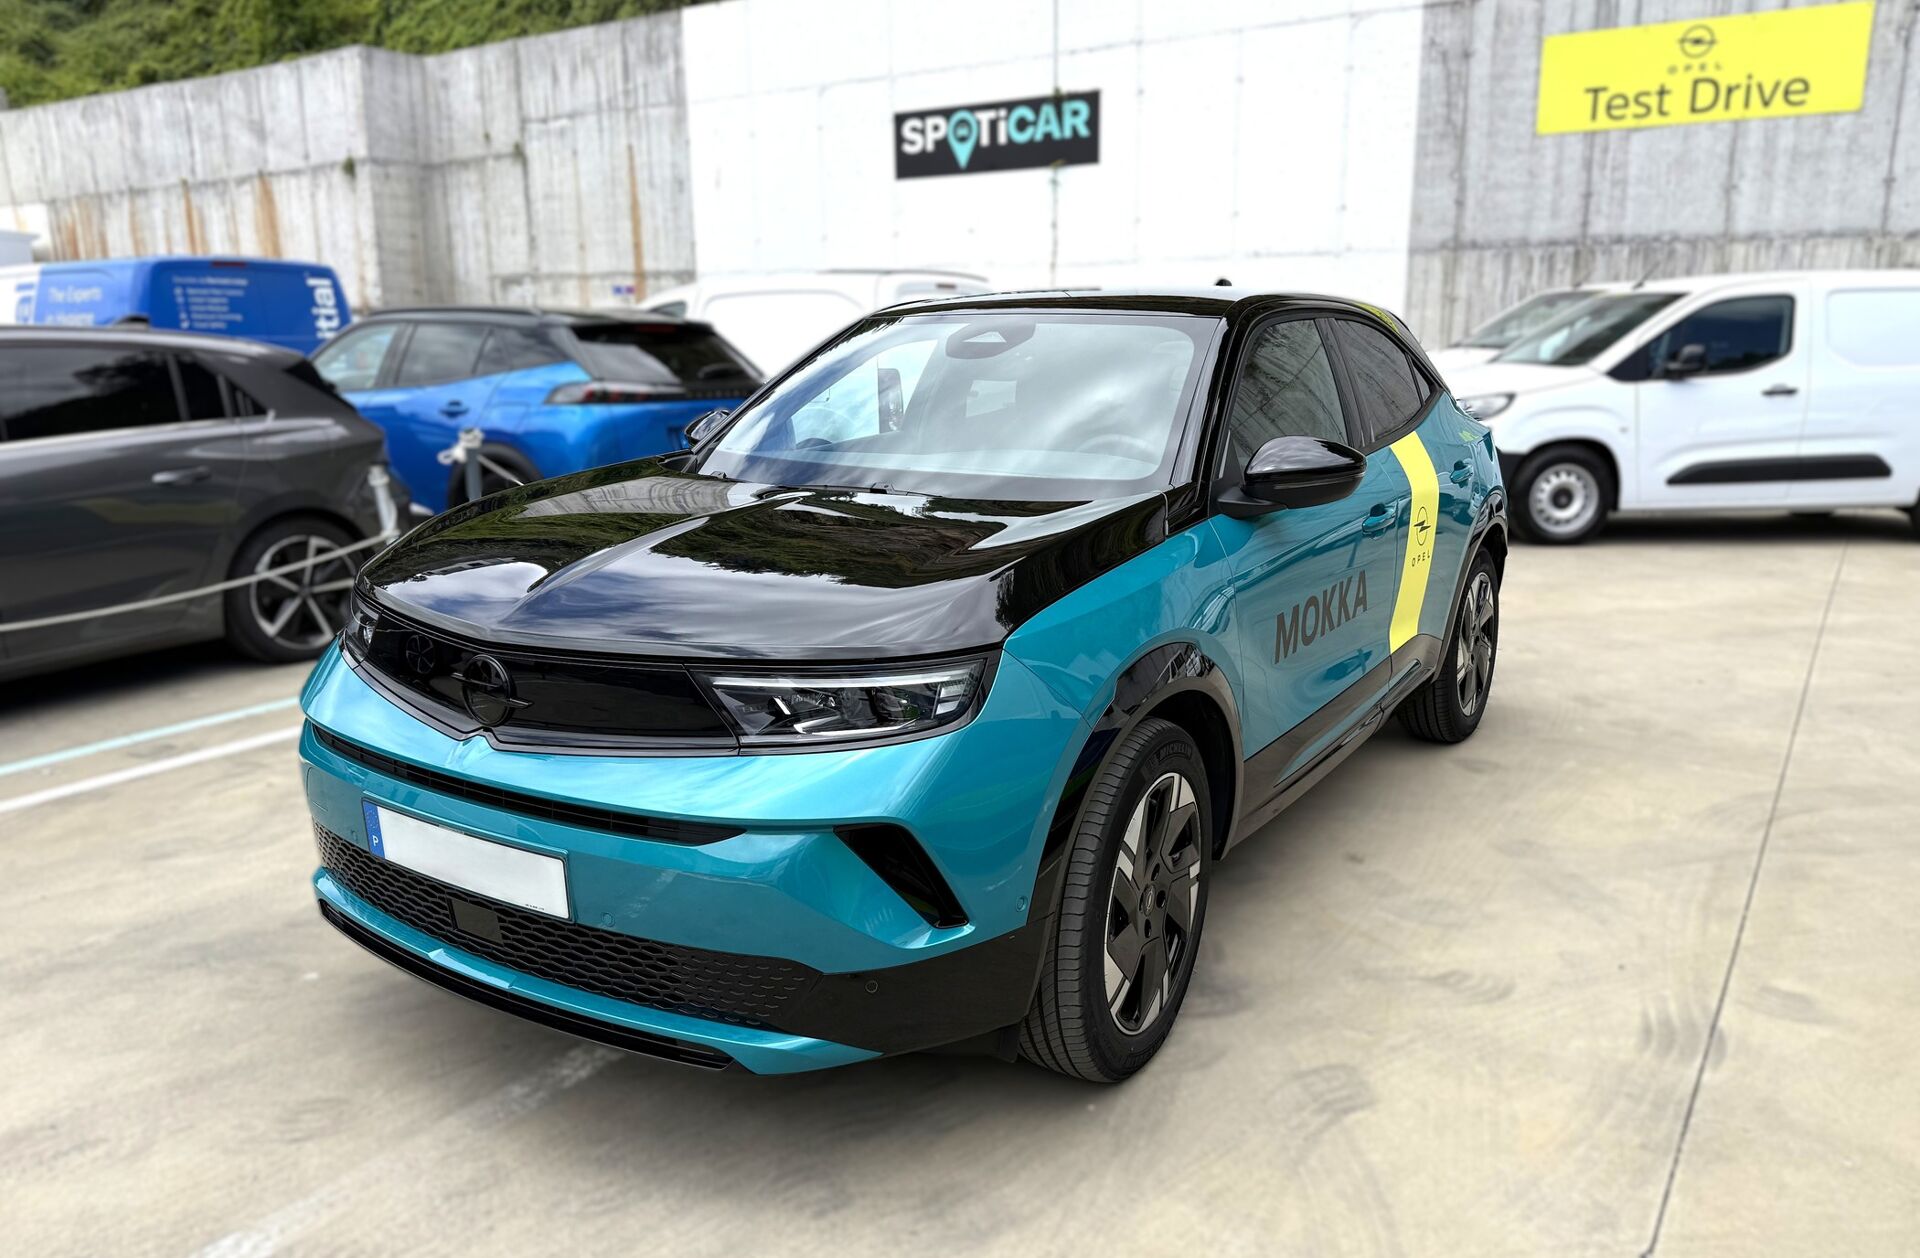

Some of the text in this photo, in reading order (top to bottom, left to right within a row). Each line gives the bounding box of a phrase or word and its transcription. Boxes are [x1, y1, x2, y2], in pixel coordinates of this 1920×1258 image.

[1667, 62, 1722, 75] OPEL
[1584, 73, 1810, 122] Test Drive
[1412, 549, 1431, 567] OPEL
[1274, 569, 1368, 665] MOKKA
[1159, 743, 1192, 762] MICHELIN
[372, 835, 380, 847] P
